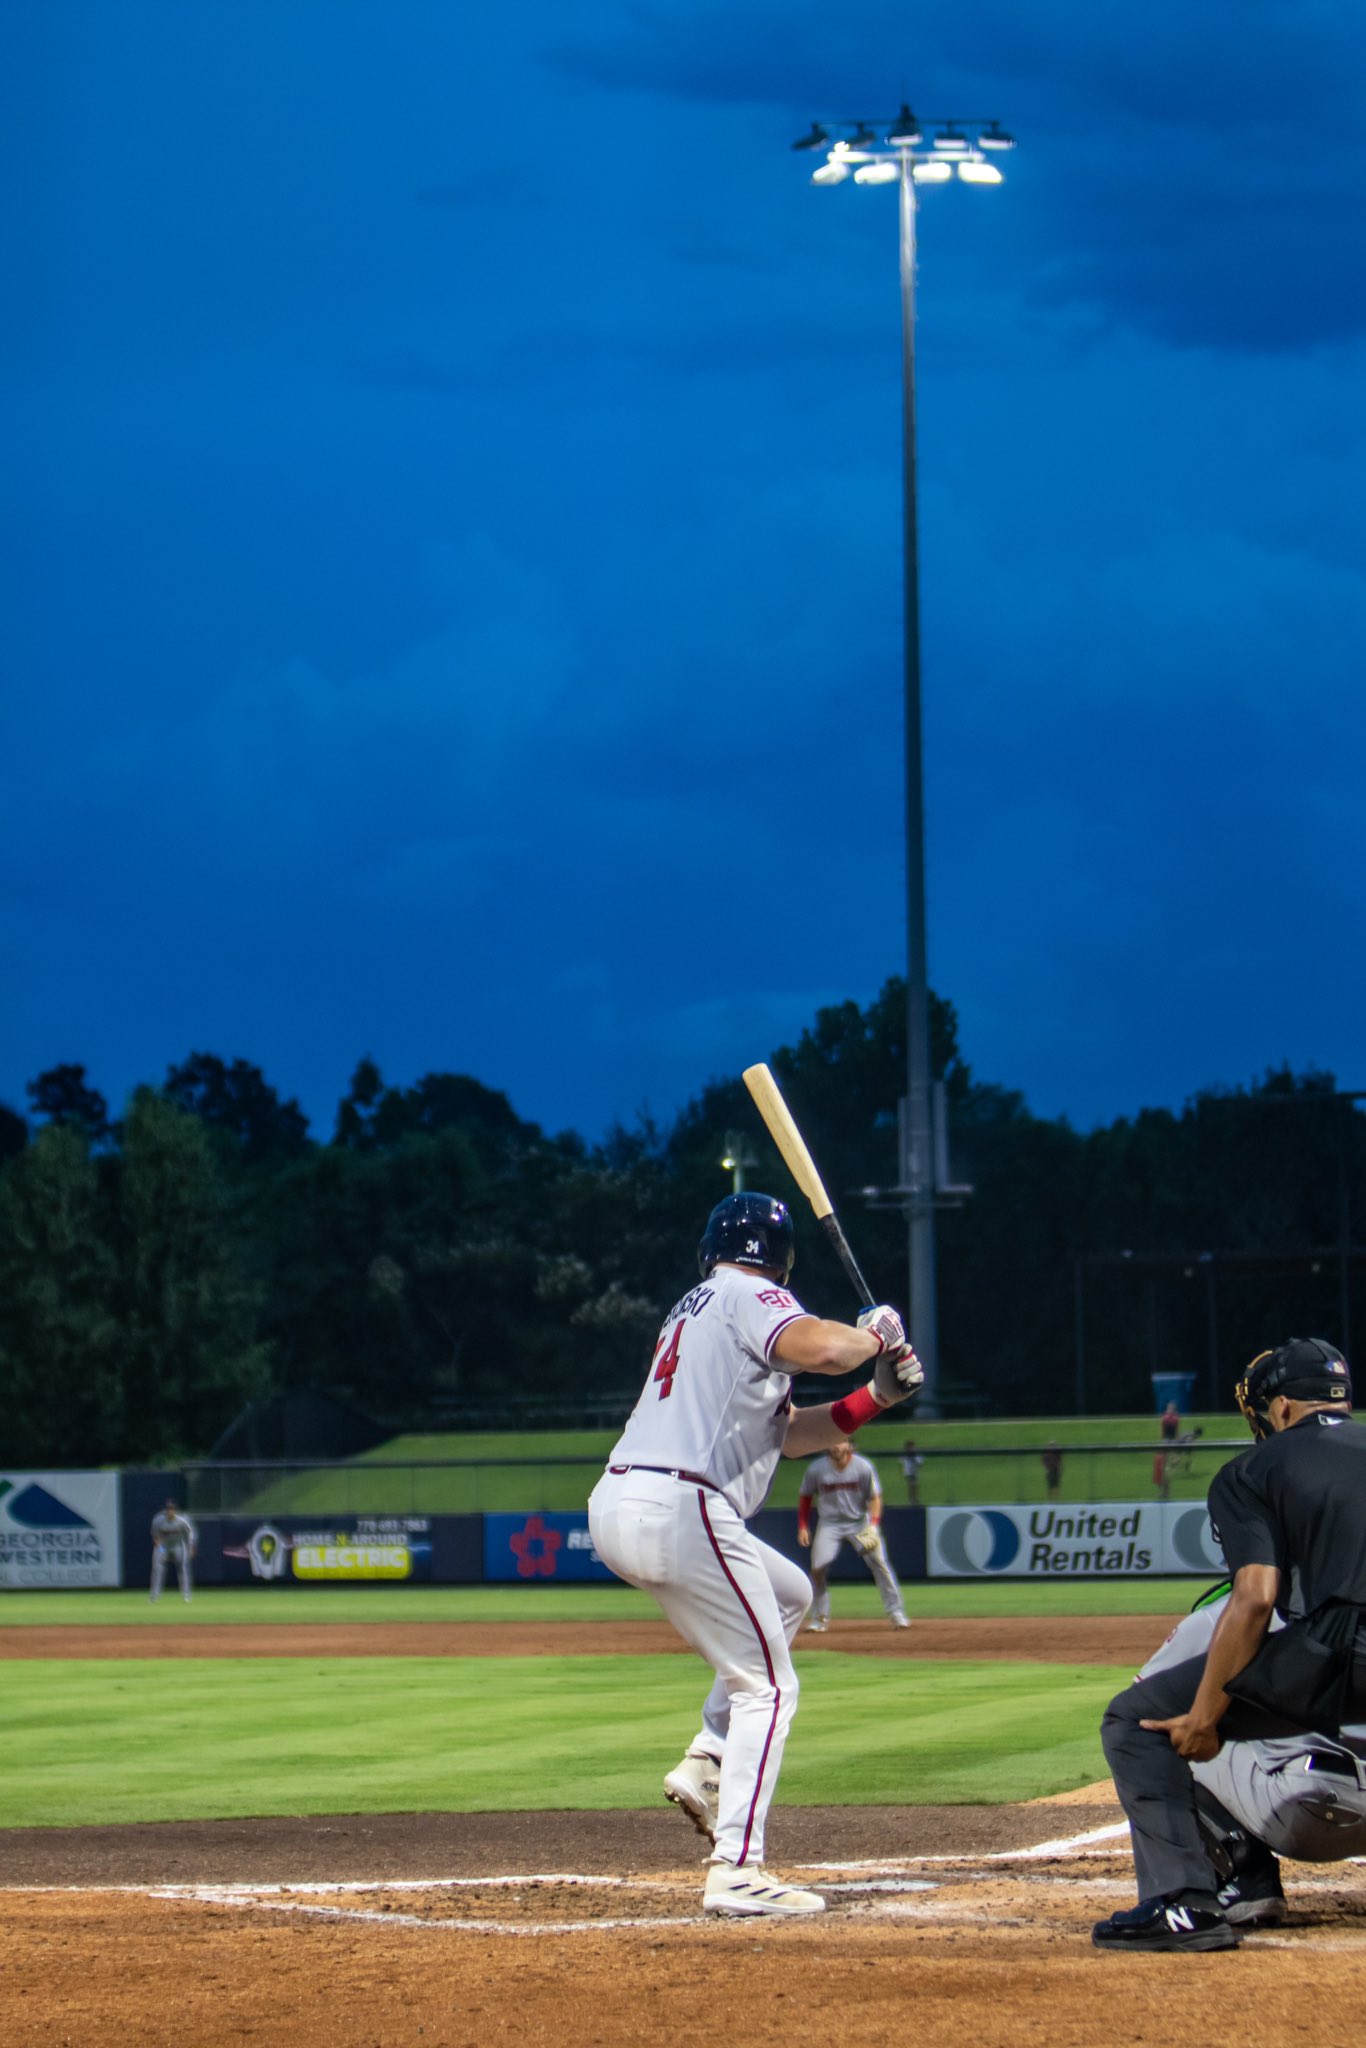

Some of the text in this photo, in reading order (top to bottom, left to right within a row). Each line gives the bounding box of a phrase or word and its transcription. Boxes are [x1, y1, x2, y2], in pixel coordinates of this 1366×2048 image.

[745, 1240, 759, 1255] 34
[652, 1318, 687, 1402] 4
[1030, 1509, 1141, 1538] United
[297, 1548, 406, 1569] ELECTRIC
[1029, 1543, 1152, 1571] Rentals
[1165, 1904, 1194, 1932] N
